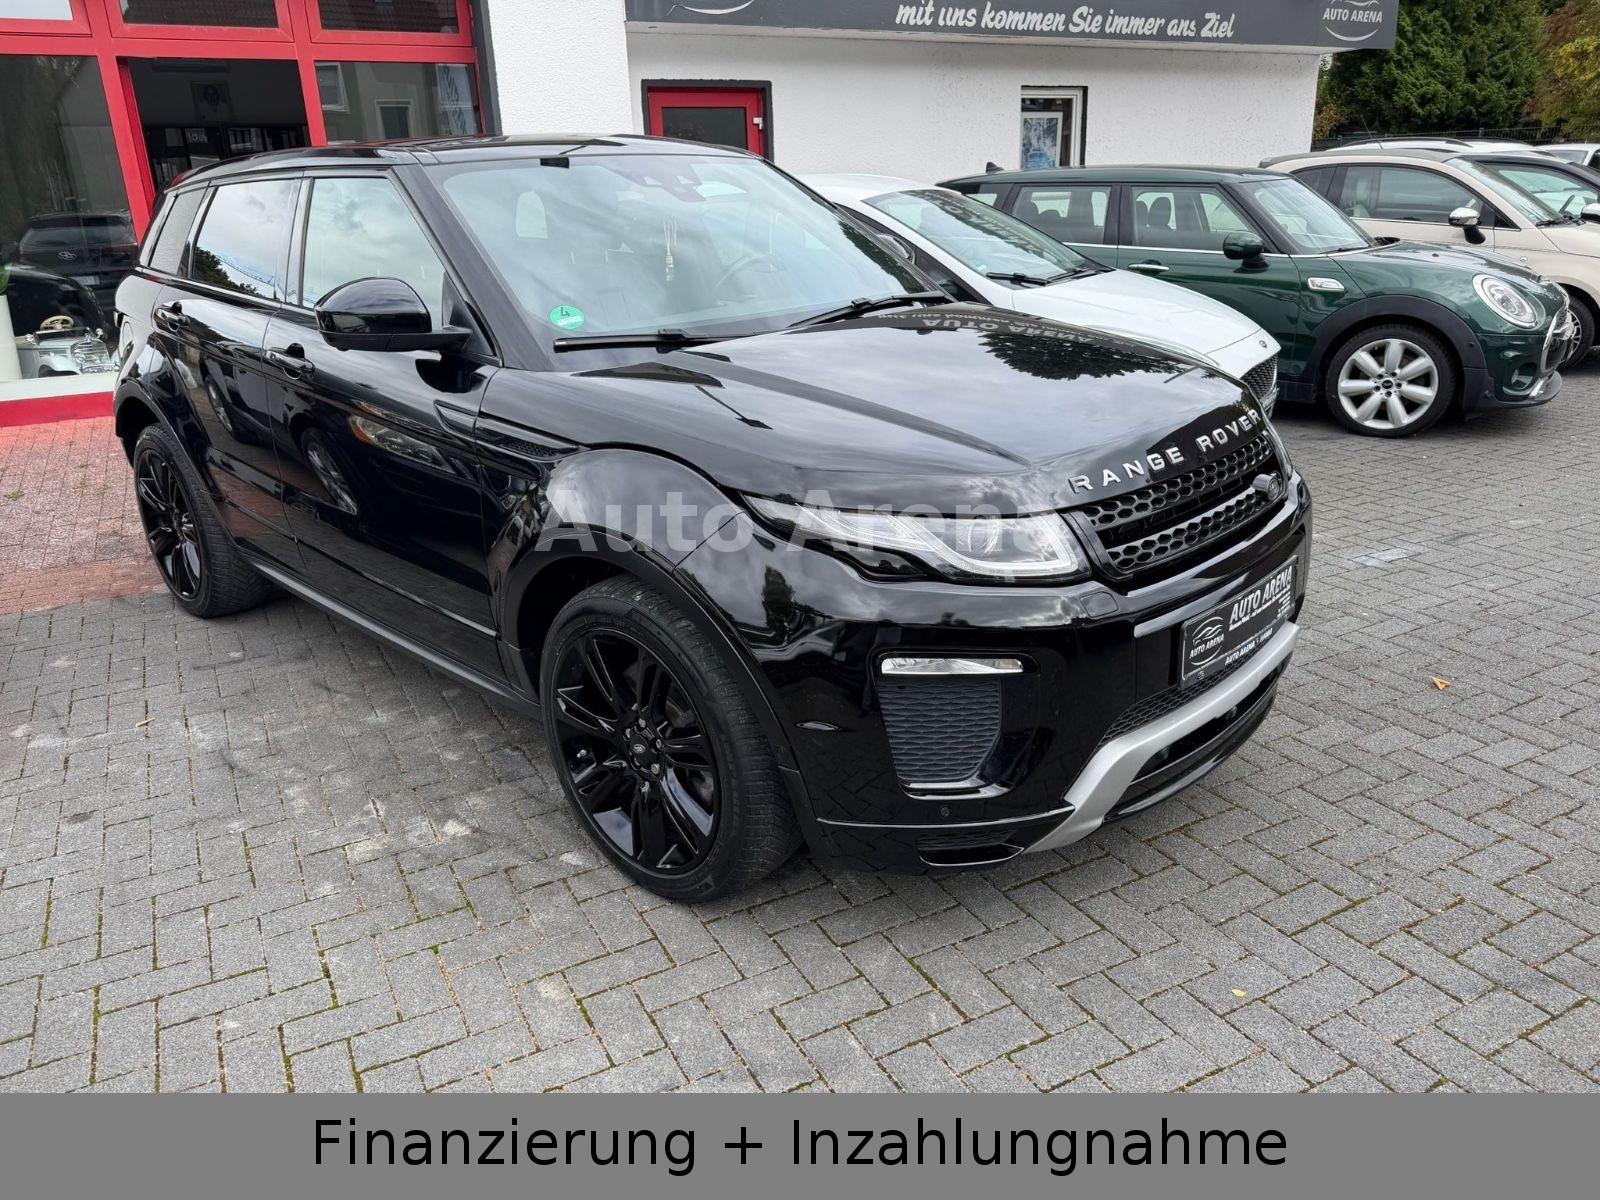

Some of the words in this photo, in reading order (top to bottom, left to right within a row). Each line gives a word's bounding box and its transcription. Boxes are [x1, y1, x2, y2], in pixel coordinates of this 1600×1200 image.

[895, 0, 934, 26] mit
[938, 6, 977, 27] uns
[980, 1, 1066, 32] kommen
[1069, 5, 1102, 34] Sie
[1105, 8, 1164, 35] immer
[1166, 18, 1197, 37] ans
[1200, 12, 1236, 39] Ziel
[1322, 7, 1349, 21] AUTO
[1350, 9, 1383, 23] ARENA
[1067, 446, 1184, 494] RANGE
[1195, 408, 1262, 452] ROVER
[1229, 589, 1261, 625] AUTO
[1262, 564, 1293, 604] ARENA
[1188, 643, 1206, 660] AUTO
[1205, 633, 1225, 651] ARENA
